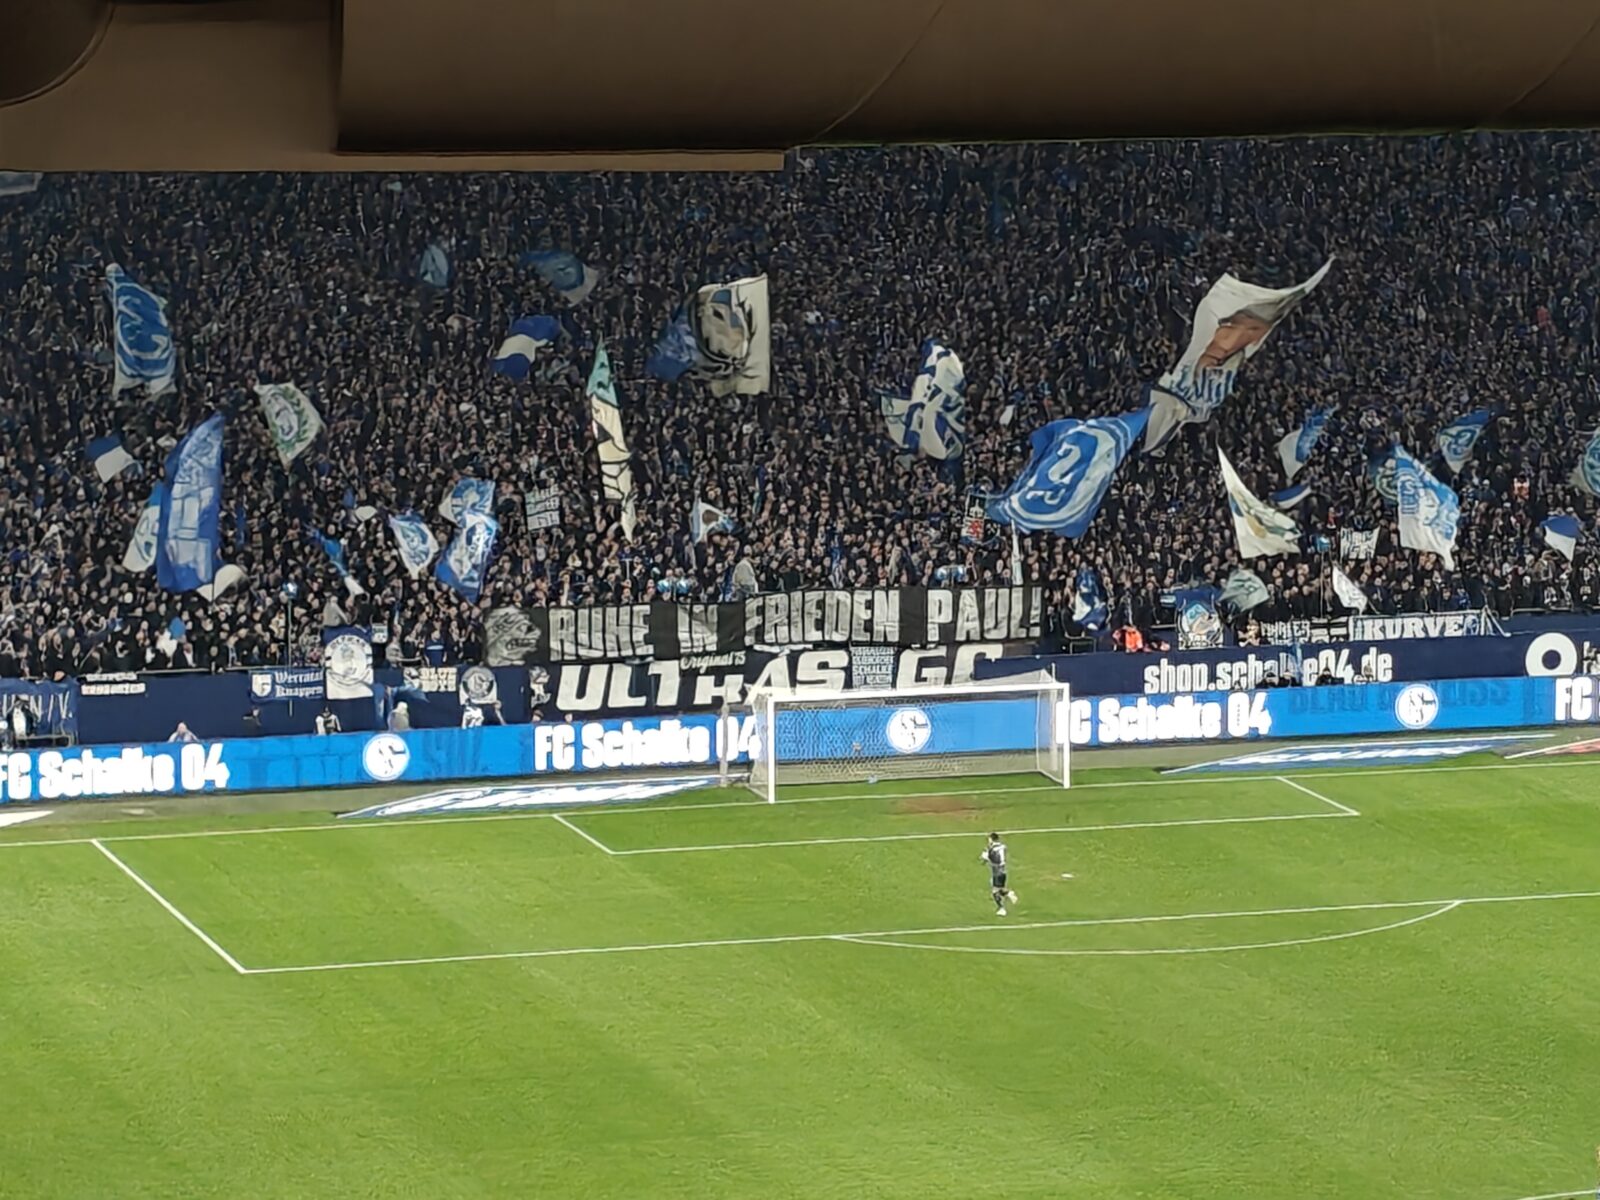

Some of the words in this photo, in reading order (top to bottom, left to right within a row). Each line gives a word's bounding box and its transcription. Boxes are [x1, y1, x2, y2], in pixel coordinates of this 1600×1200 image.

[548, 604, 655, 661] RUHE
[677, 604, 719, 653] IN
[744, 589, 899, 646] FRIEDEN
[926, 586, 1042, 642] PAUL!
[1363, 616, 1464, 640] KURVE
[1143, 647, 1393, 694] shop.schale04.de
[1098, 696, 1221, 742] Schalke
[1225, 692, 1272, 736] 04
[1555, 676, 1593, 721] FC
[534, 724, 575, 770] FC
[581, 719, 710, 768] Schalke
[715, 716, 760, 761] 04
[38, 747, 175, 798] Schalke
[180, 743, 230, 790] 04
